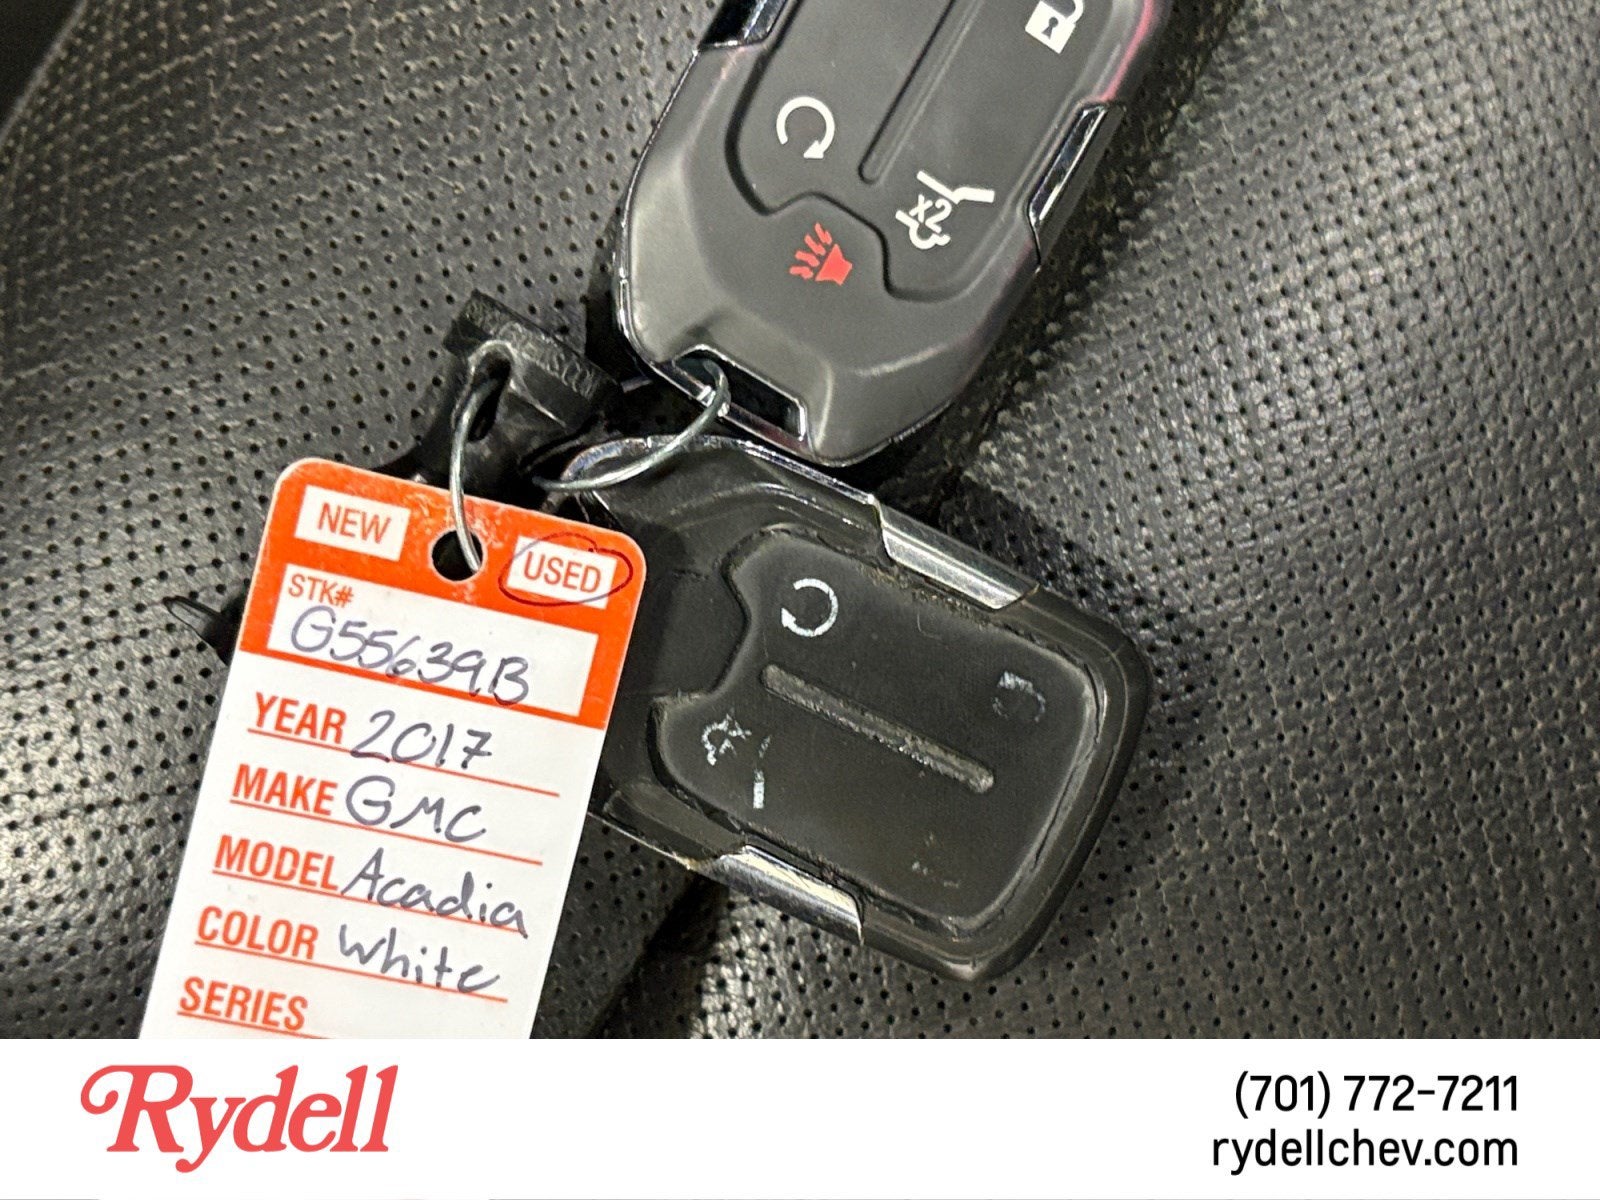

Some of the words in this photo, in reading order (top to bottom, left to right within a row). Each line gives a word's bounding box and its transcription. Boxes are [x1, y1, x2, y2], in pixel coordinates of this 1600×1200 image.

[318, 502, 394, 544] NEW
[288, 574, 353, 608] STK#
[523, 552, 601, 595] USED
[291, 605, 529, 706] G55639B
[255, 692, 348, 745] YEAR
[350, 710, 493, 769] 2017
[232, 763, 338, 816] MAKE
[346, 775, 487, 843] GMC
[214, 834, 341, 892] MODEL
[341, 847, 529, 939] Acadia
[197, 905, 319, 960] COLOR
[179, 976, 309, 1031] SERIES
